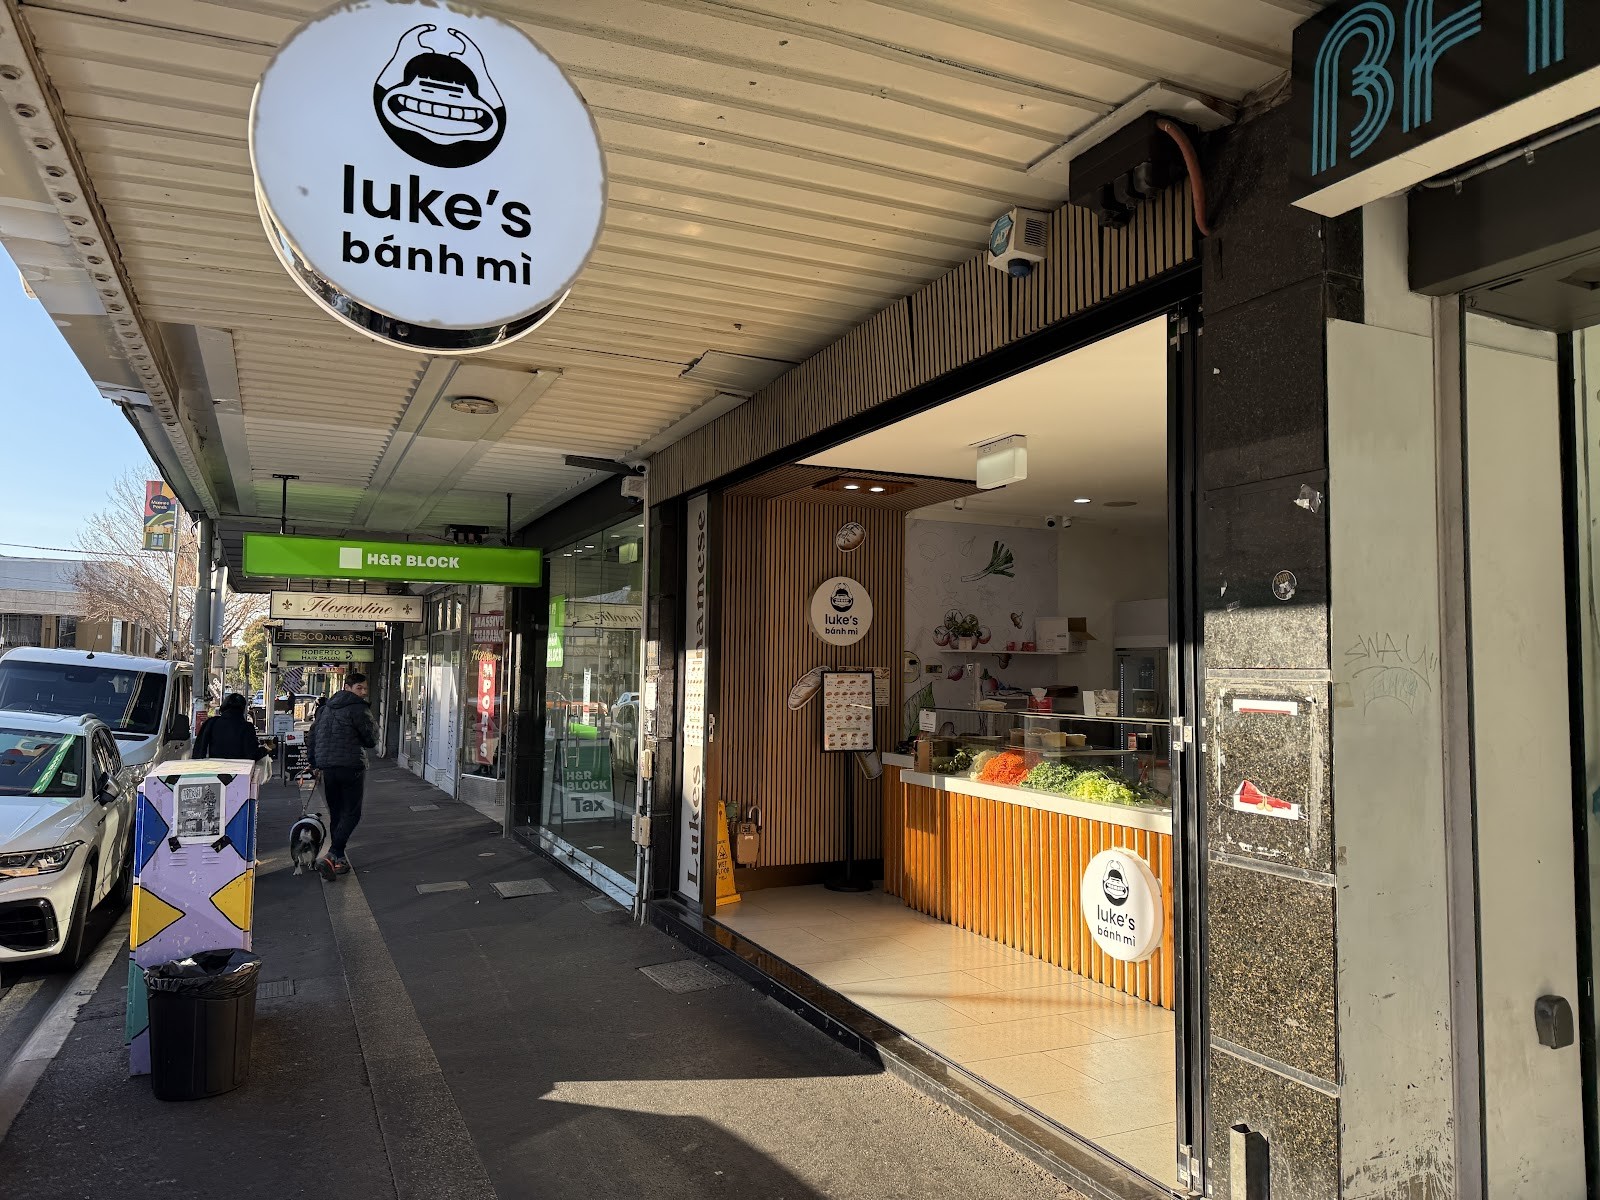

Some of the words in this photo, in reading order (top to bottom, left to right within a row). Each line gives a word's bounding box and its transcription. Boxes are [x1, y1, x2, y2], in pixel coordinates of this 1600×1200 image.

[342, 231, 464, 277] bánh
[476, 252, 531, 286] mì
[367, 553, 401, 566] H&R
[406, 555, 459, 569] BLOCK
[302, 596, 393, 615] Florentine
[277, 631, 324, 641] FRESCO
[567, 771, 592, 781] H&R
[567, 780, 608, 791] BLOCK
[571, 797, 606, 813] Tax
[1097, 904, 1136, 931] luke's
[1097, 925, 1121, 942] bánh
